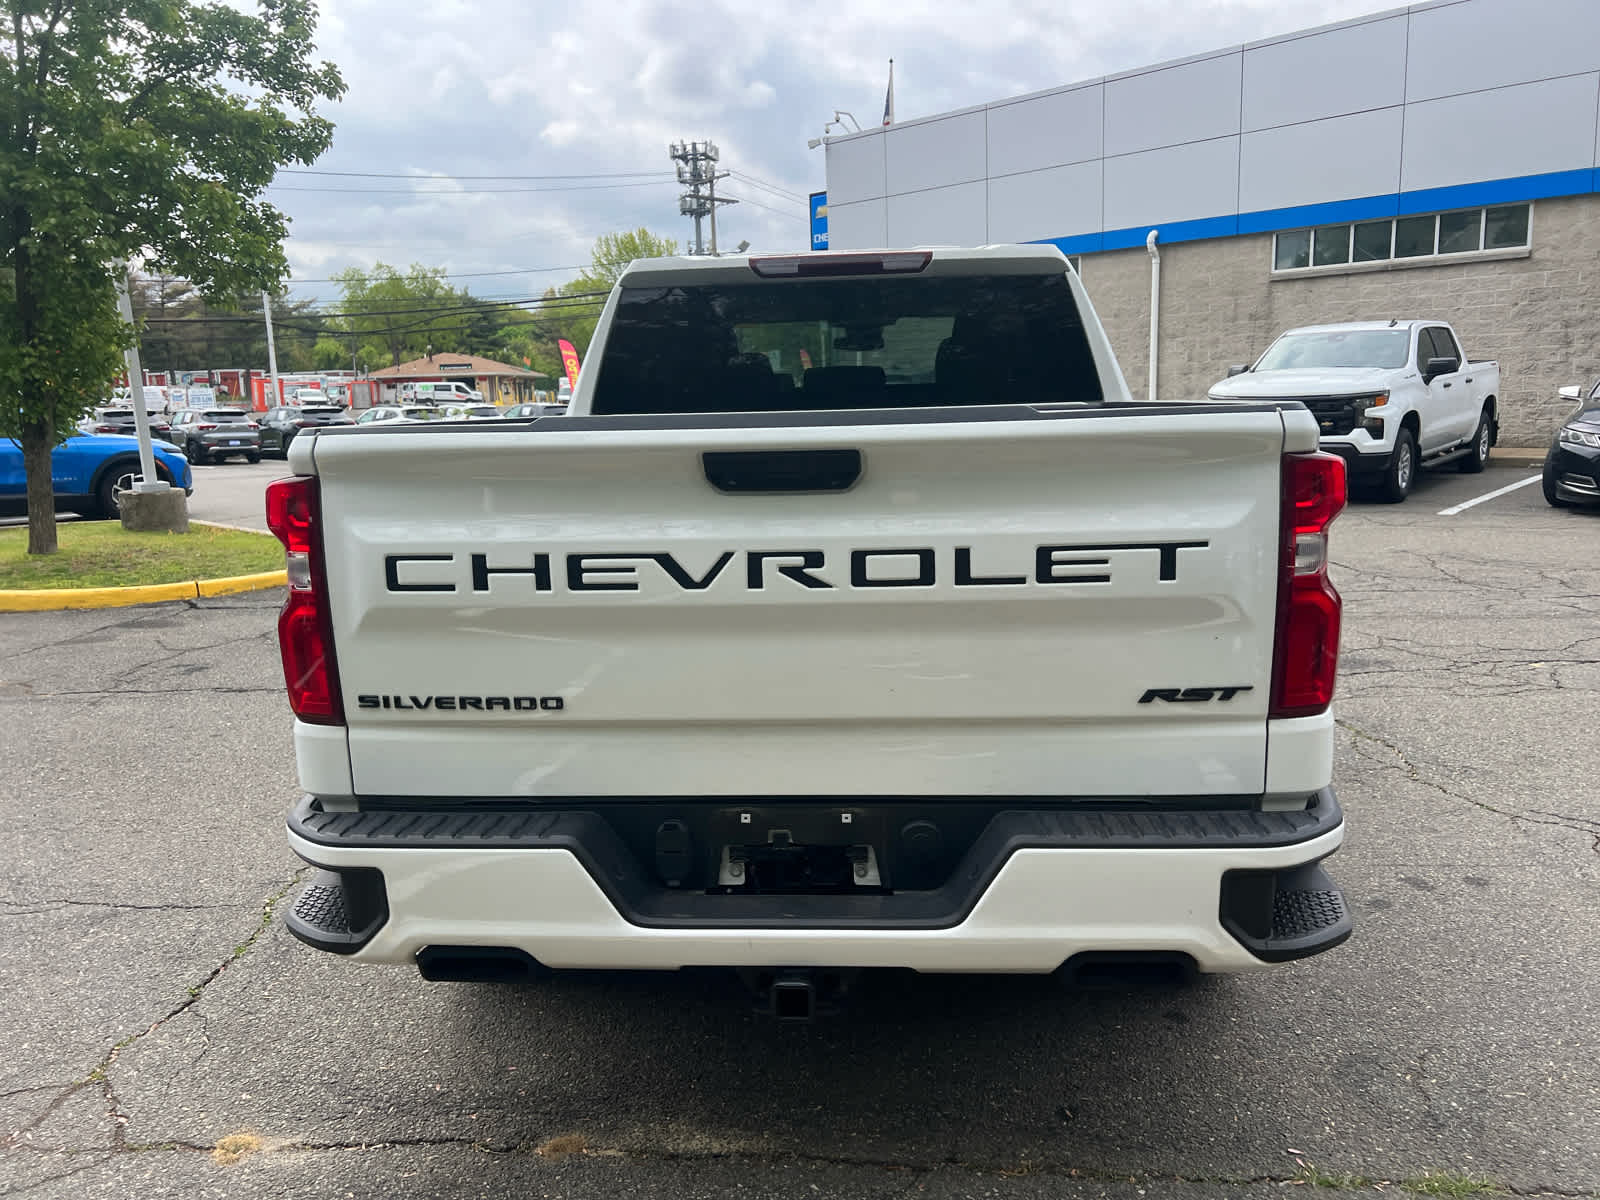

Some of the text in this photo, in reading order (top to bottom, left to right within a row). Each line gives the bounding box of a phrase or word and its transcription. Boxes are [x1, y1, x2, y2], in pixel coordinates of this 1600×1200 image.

[384, 541, 1209, 592] CHEVROLET
[357, 694, 565, 711] SILVERADO
[1137, 686, 1254, 704] RST
